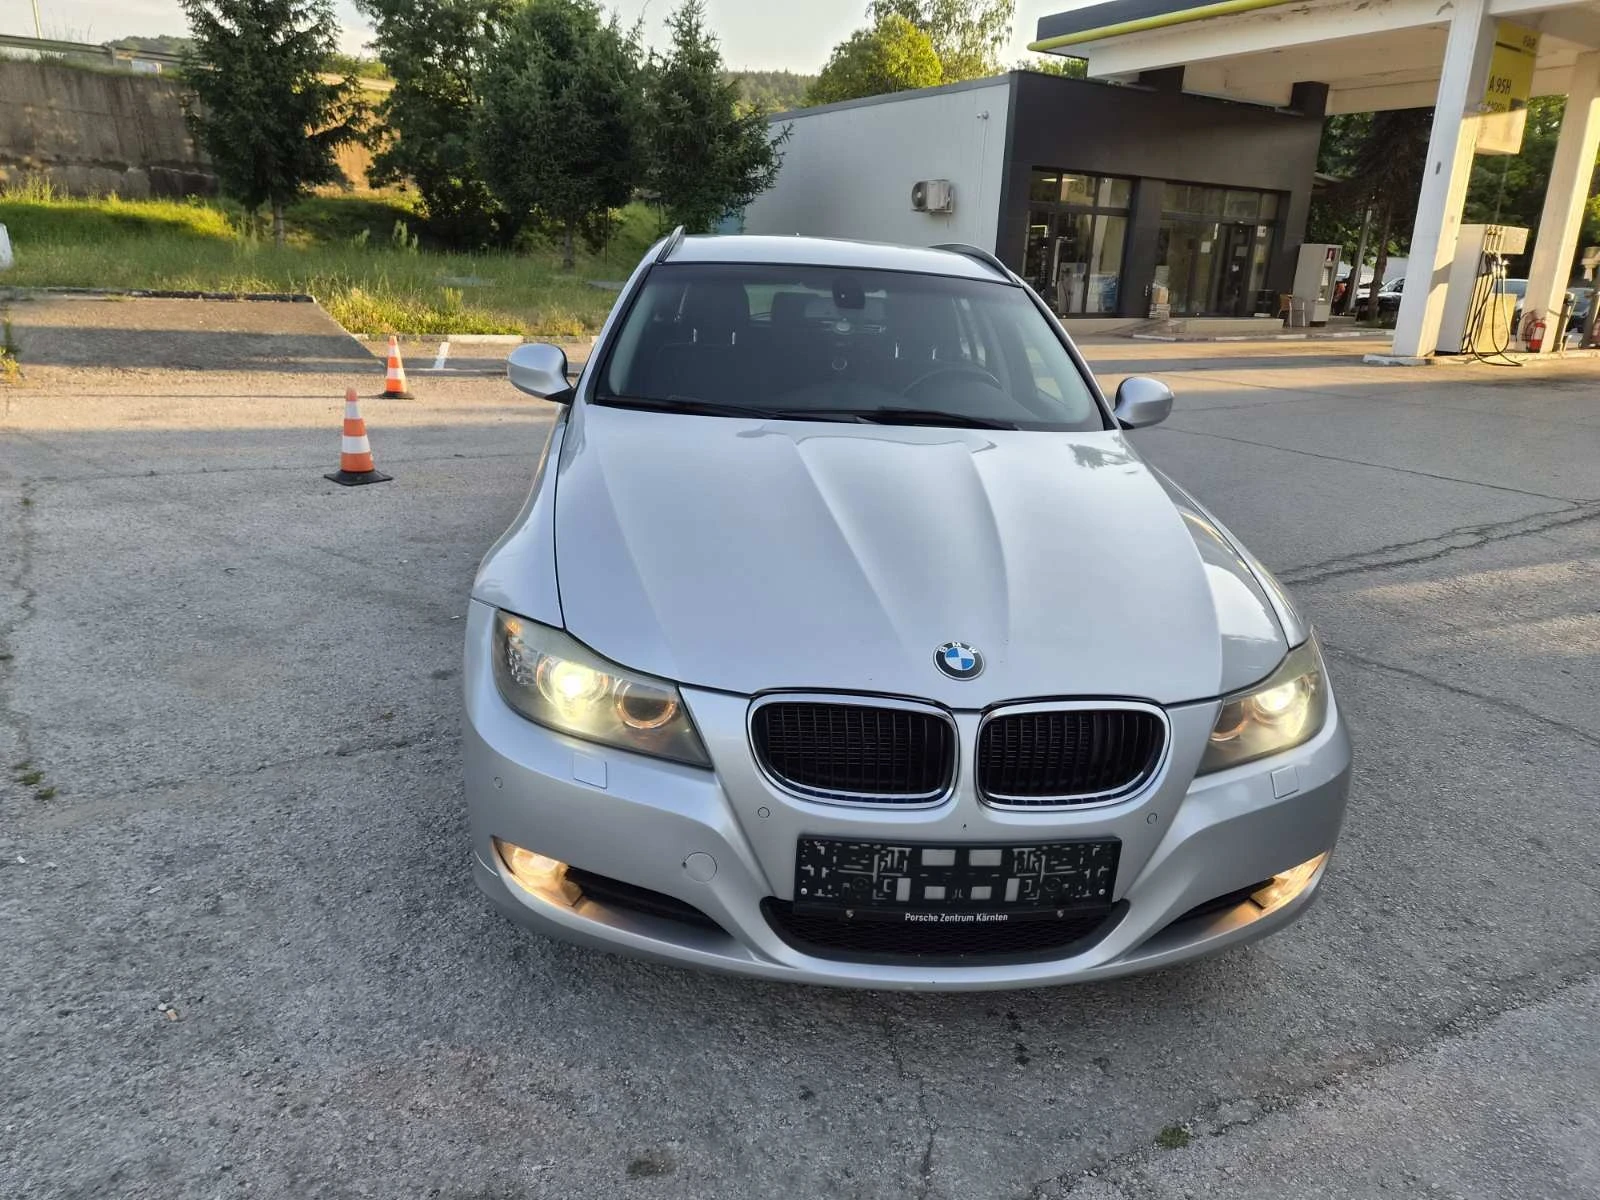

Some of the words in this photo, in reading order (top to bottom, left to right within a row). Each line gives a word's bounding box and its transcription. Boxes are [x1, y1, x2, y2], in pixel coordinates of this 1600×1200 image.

[905, 912, 939, 922] Porsche
[940, 913, 975, 922] Zentrum
[976, 912, 1009, 922] Kärnten
